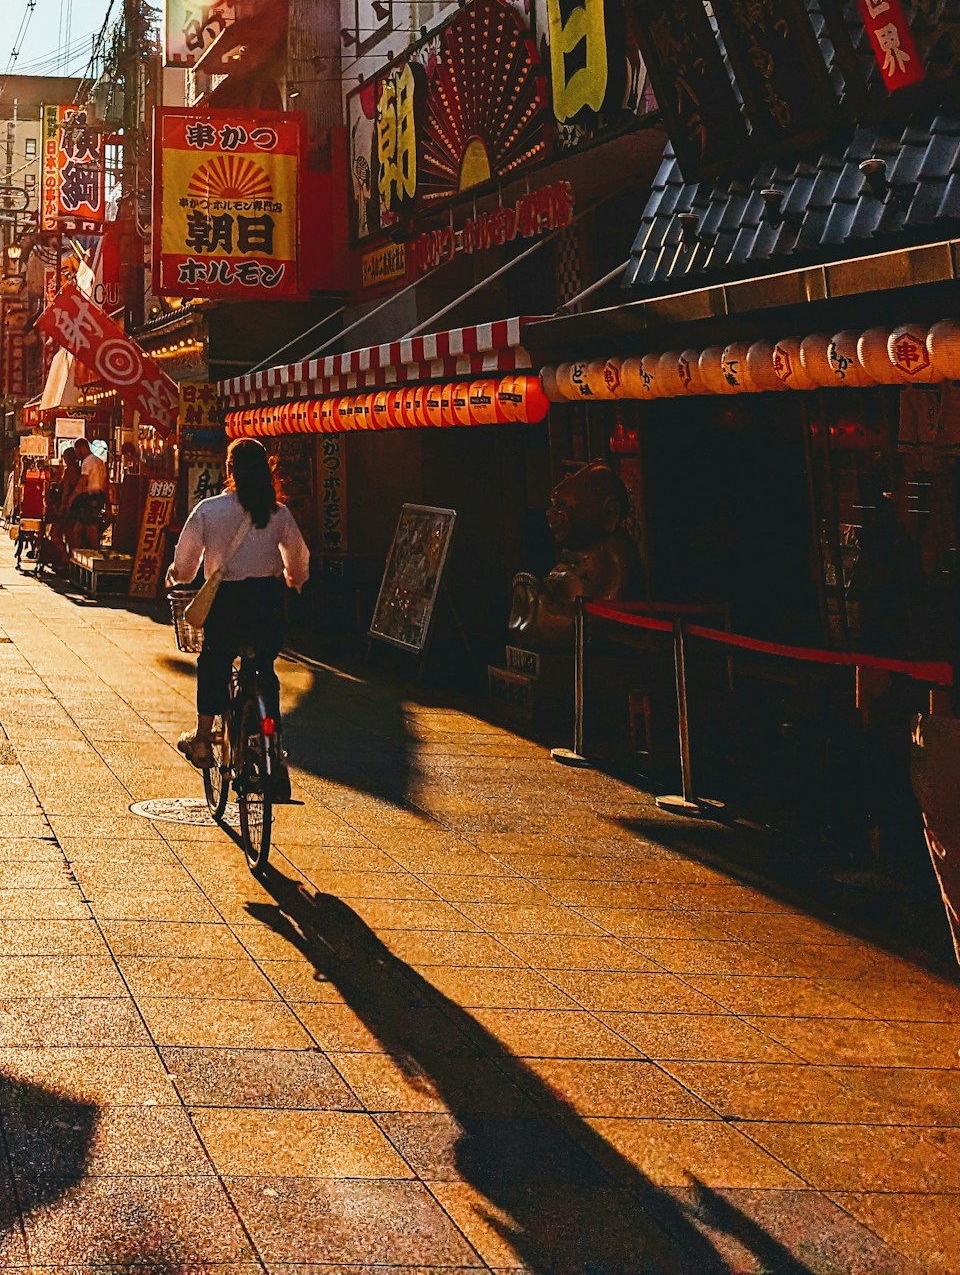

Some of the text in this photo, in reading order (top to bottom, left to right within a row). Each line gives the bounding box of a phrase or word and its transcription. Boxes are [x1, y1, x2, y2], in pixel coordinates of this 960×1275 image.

[185, 121, 279, 151] 串かつ
[44, 139, 58, 231] 日本一の串かつ
[185, 209, 275, 256] 朝日
[178, 257, 285, 290] ホルモン
[136, 499, 170, 582] 割引券
